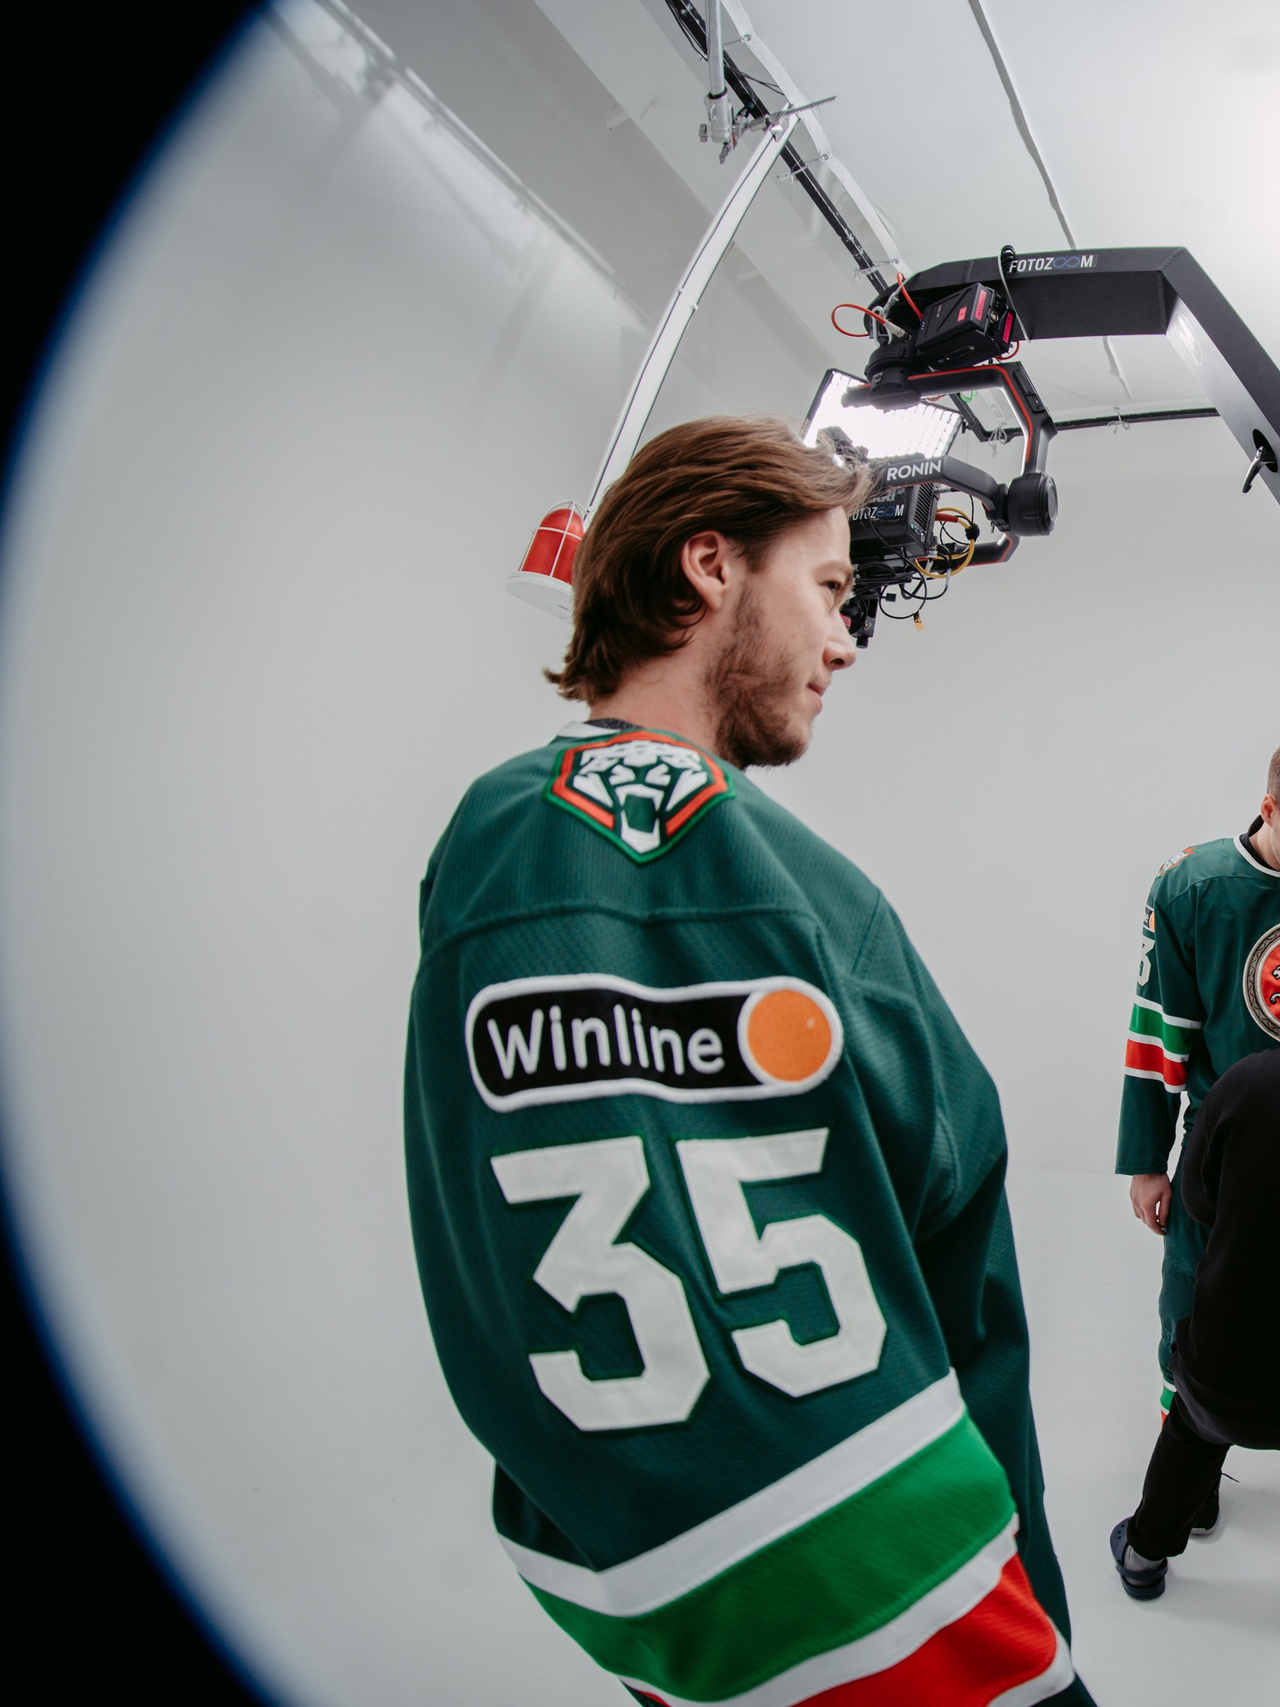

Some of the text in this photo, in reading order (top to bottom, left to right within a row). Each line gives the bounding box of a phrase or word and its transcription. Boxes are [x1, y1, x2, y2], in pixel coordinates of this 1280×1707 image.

[886, 460, 942, 482] RONIN
[486, 1004, 726, 1080] Winline
[490, 1126, 888, 1433] 35
